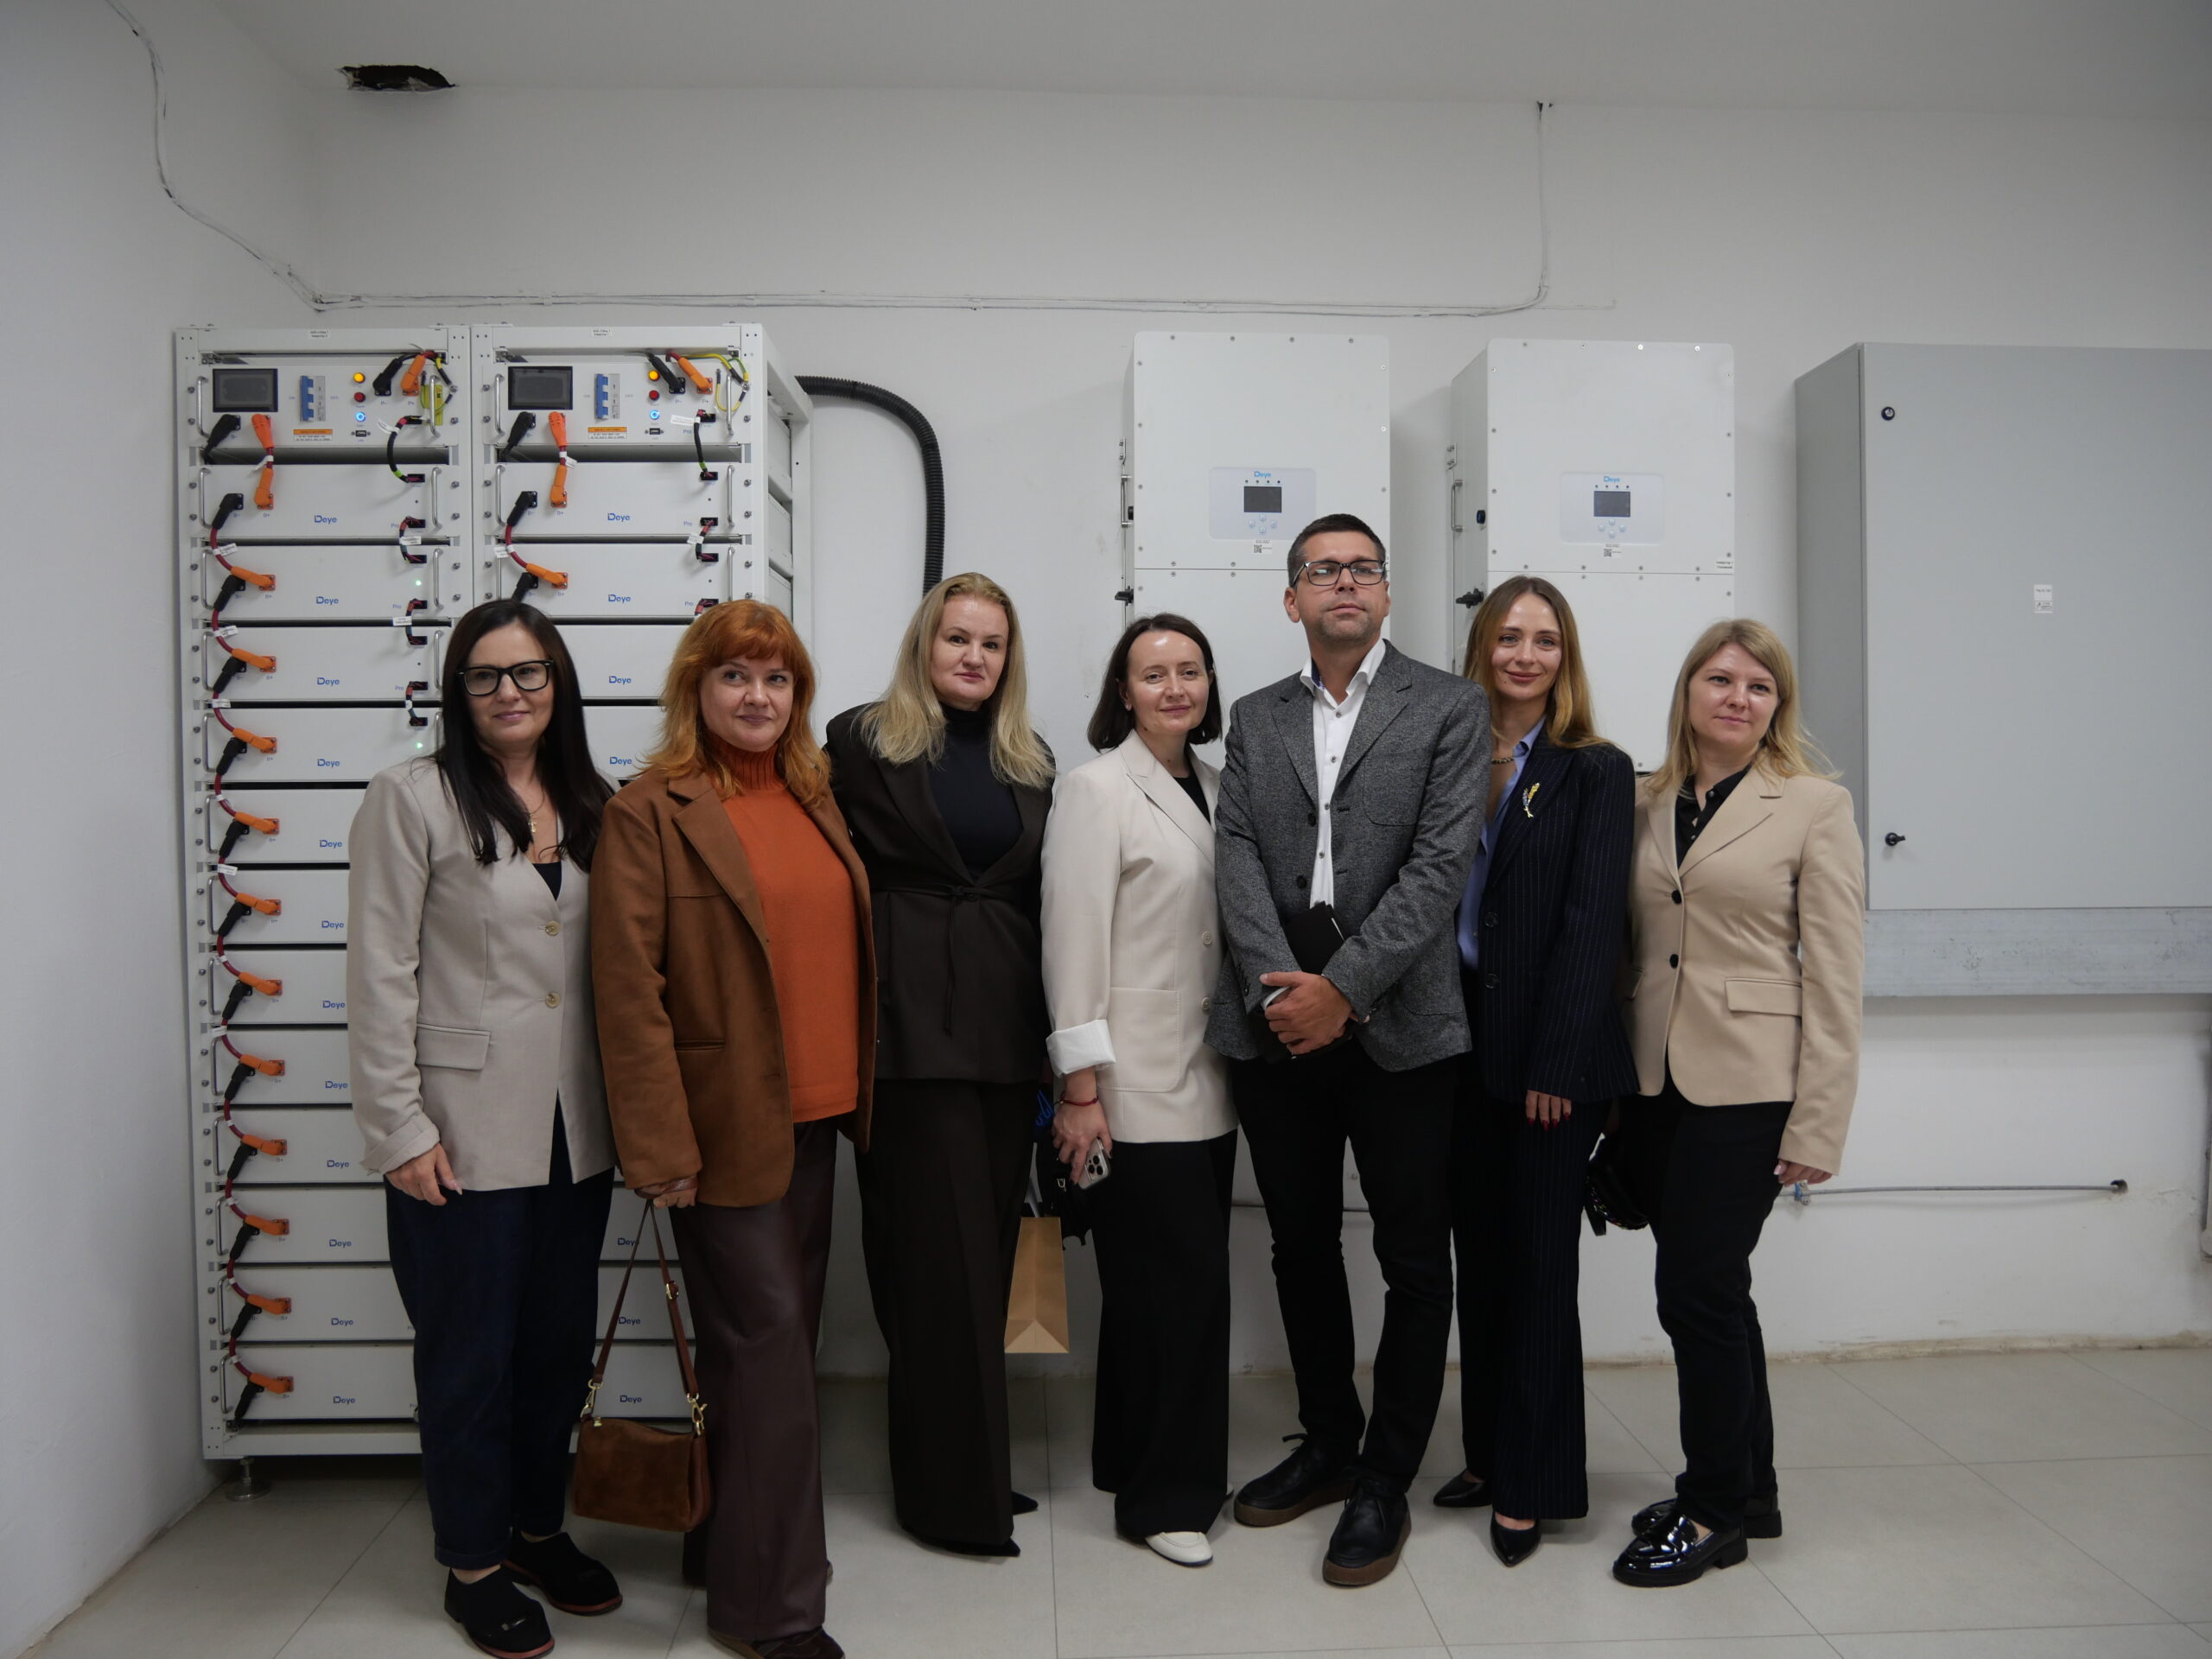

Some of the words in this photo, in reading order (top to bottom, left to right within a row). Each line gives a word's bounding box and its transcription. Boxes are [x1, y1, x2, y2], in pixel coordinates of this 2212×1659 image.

[315, 515, 337, 524] Deye
[607, 513, 630, 522] Deye
[316, 595, 339, 605] Deye
[608, 594, 631, 603] Deye
[317, 677, 340, 686] Deye
[608, 676, 632, 684] Deye
[317, 759, 340, 767] Deye
[609, 756, 632, 766] Deye
[320, 840, 342, 849] Deye
[321, 920, 344, 929] Deye
[322, 1001, 346, 1009] Deye
[325, 1081, 347, 1090] Deye
[327, 1160, 349, 1168] Deye
[329, 1239, 352, 1248] Deye
[331, 1318, 353, 1326] Deye
[619, 1317, 640, 1325] Deye
[334, 1396, 356, 1405] Deye
[620, 1395, 642, 1403] Deye
